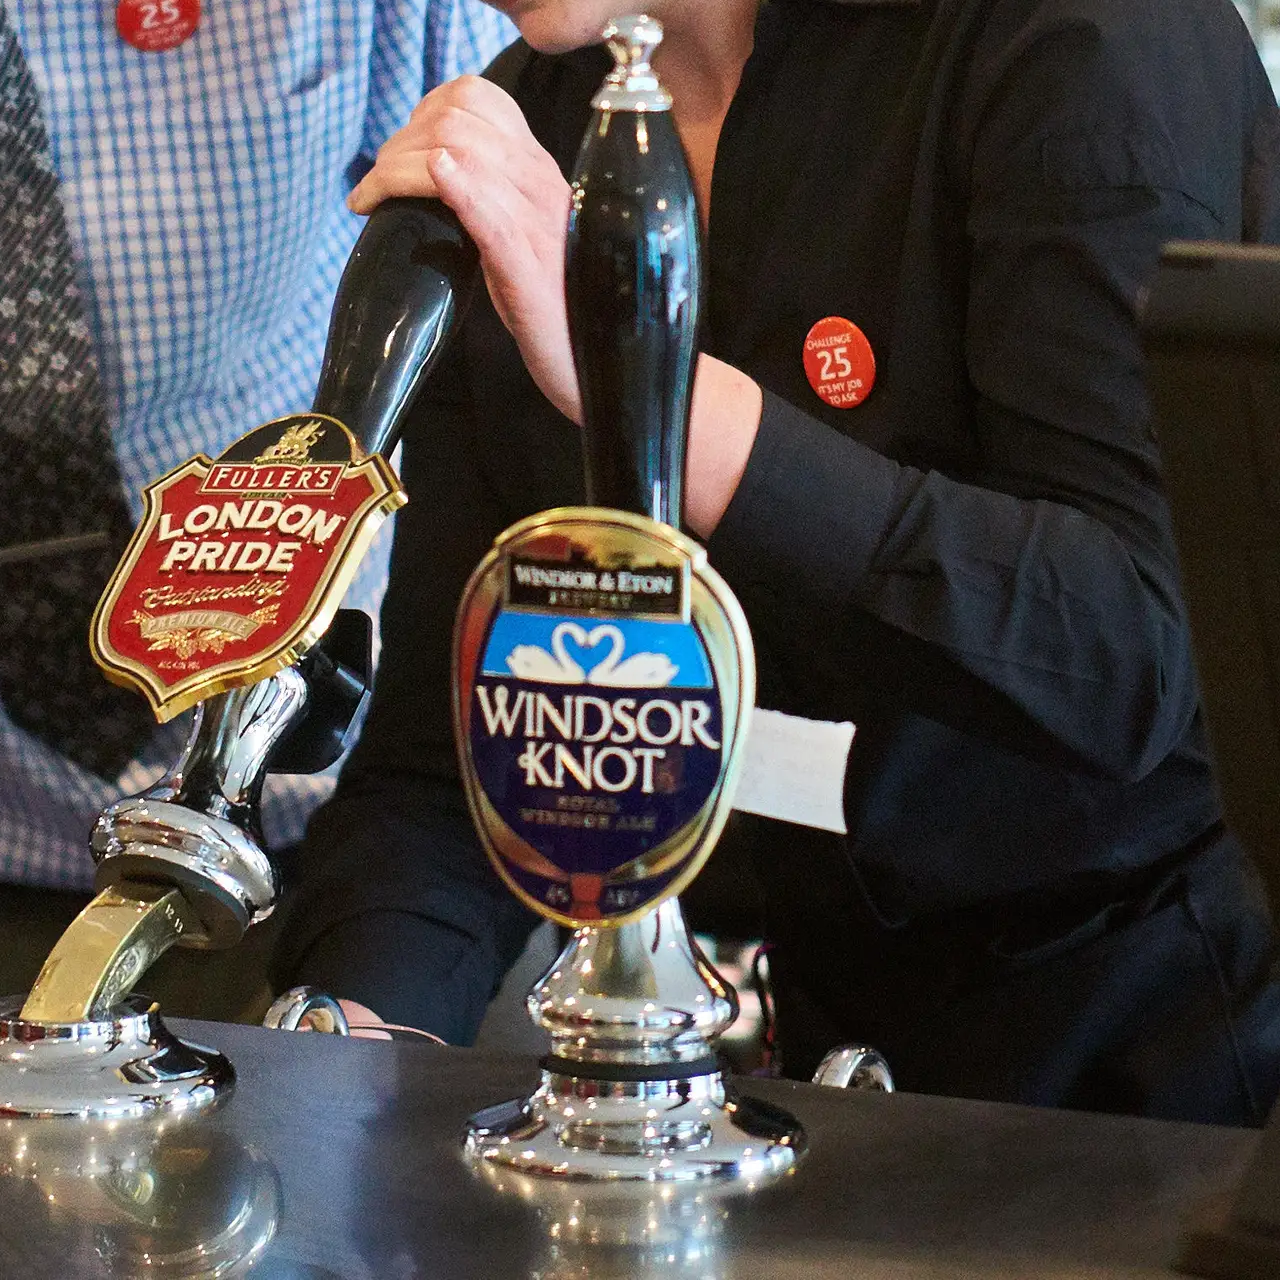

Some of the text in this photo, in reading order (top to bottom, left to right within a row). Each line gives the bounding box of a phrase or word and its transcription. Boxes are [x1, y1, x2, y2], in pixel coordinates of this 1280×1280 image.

[806, 333, 852, 351] CHALLENGE
[816, 347, 852, 381] 25
[829, 392, 858, 405] TO ASK
[832, 382, 846, 393] MY
[847, 379, 862, 392] JOB
[212, 466, 333, 489] FULLER'S
[158, 500, 346, 545] LONDON
[163, 540, 302, 574] PRIDE
[139, 573, 290, 609] Outstanding
[515, 564, 673, 594] WINDSOR & ETON
[148, 613, 247, 634] PREMIUM ALE
[476, 685, 721, 750] WINDSOR
[518, 741, 667, 794] KNOT
